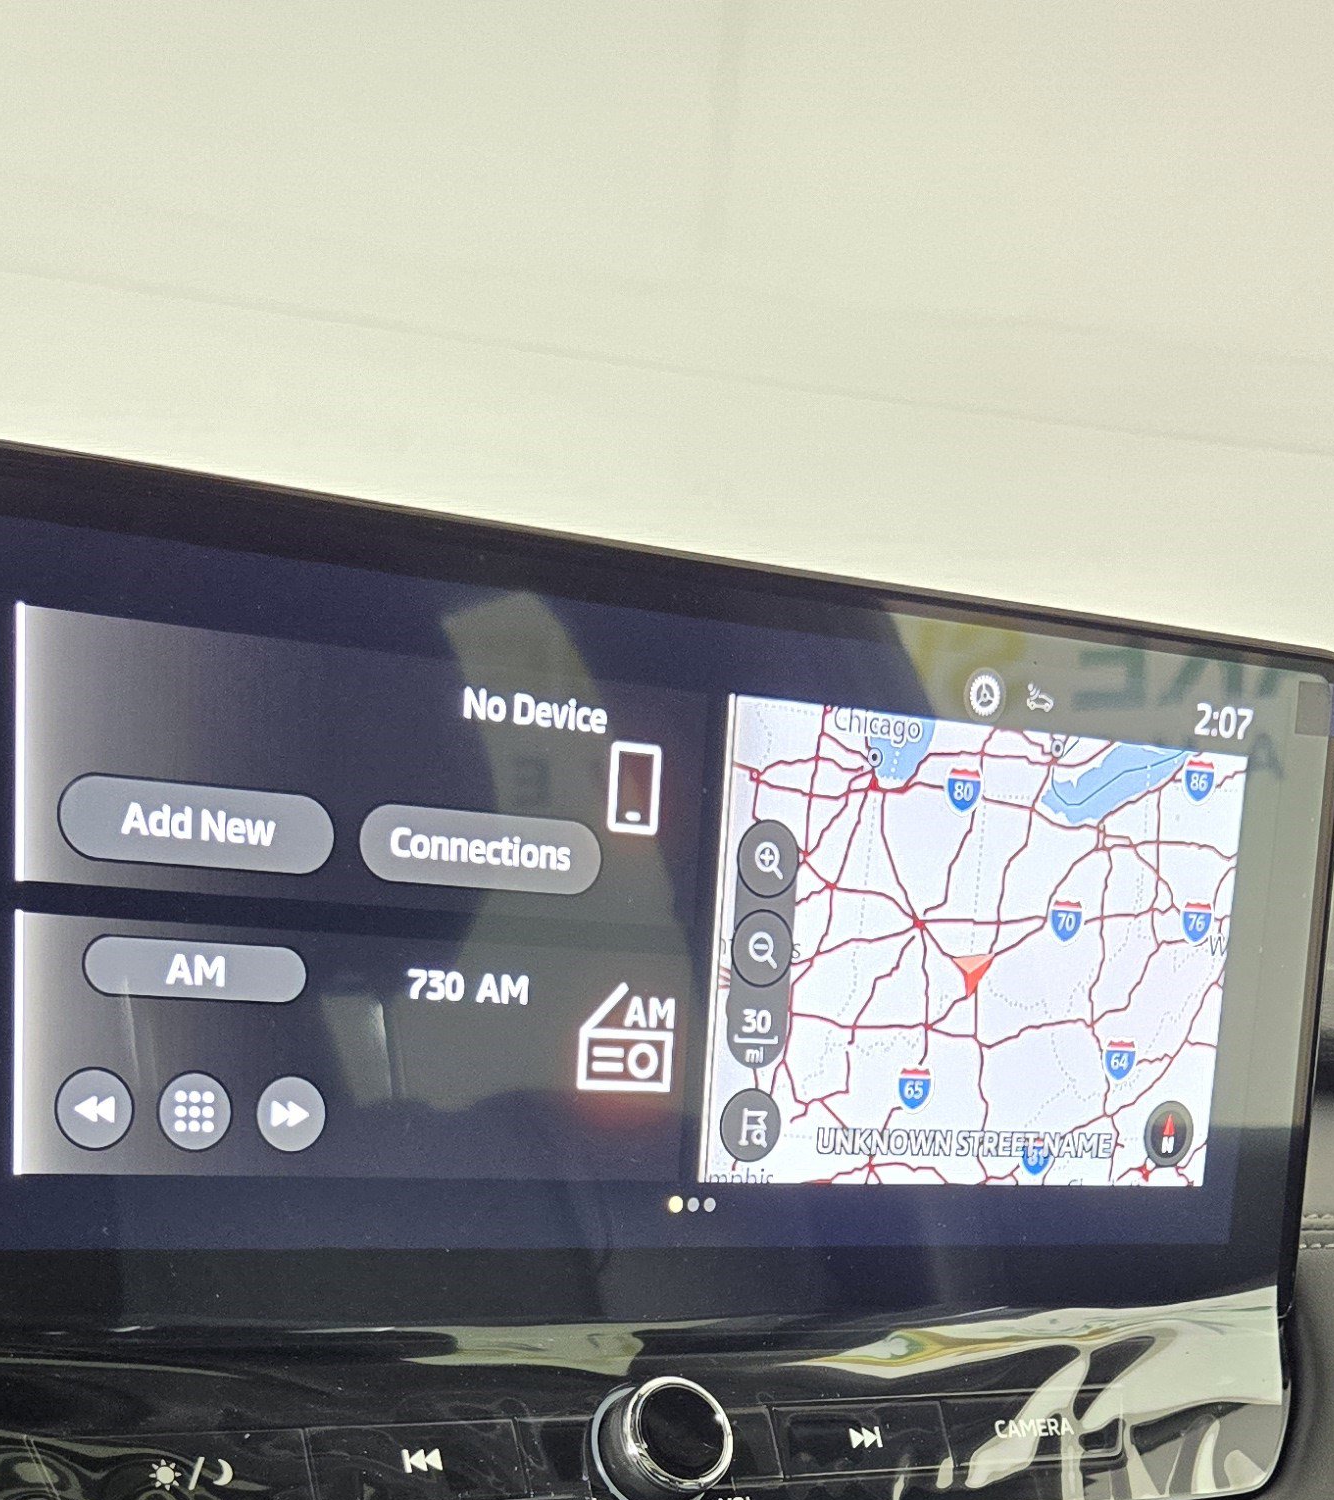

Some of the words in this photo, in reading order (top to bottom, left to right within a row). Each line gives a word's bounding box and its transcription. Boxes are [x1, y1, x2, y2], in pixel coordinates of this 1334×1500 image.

[462, 687, 506, 723] No
[512, 693, 608, 735] Device
[1193, 703, 1254, 741] 2:07
[833, 708, 922, 746] Chicago
[953, 781, 973, 803] 80
[1190, 773, 1209, 792] 86
[120, 802, 193, 842] Add
[199, 809, 276, 848] New
[389, 827, 571, 872] Connections
[1057, 912, 1076, 932] 70
[1188, 913, 1207, 933] 76
[165, 954, 226, 988] AM
[407, 968, 465, 1002] 730
[475, 973, 530, 1006] AM
[623, 997, 676, 1030] AM
[741, 1008, 772, 1034] 30
[744, 1047, 764, 1064] mi
[1110, 1053, 1130, 1072] 64
[904, 1080, 925, 1100] 65
[816, 1127, 952, 1157] UNKNOWN
[955, 1130, 1041, 1158] STREET
[1041, 1132, 1113, 1159] NAME
[1161, 1136, 1175, 1154] N
[994, 1417, 1075, 1440] CAMERA
